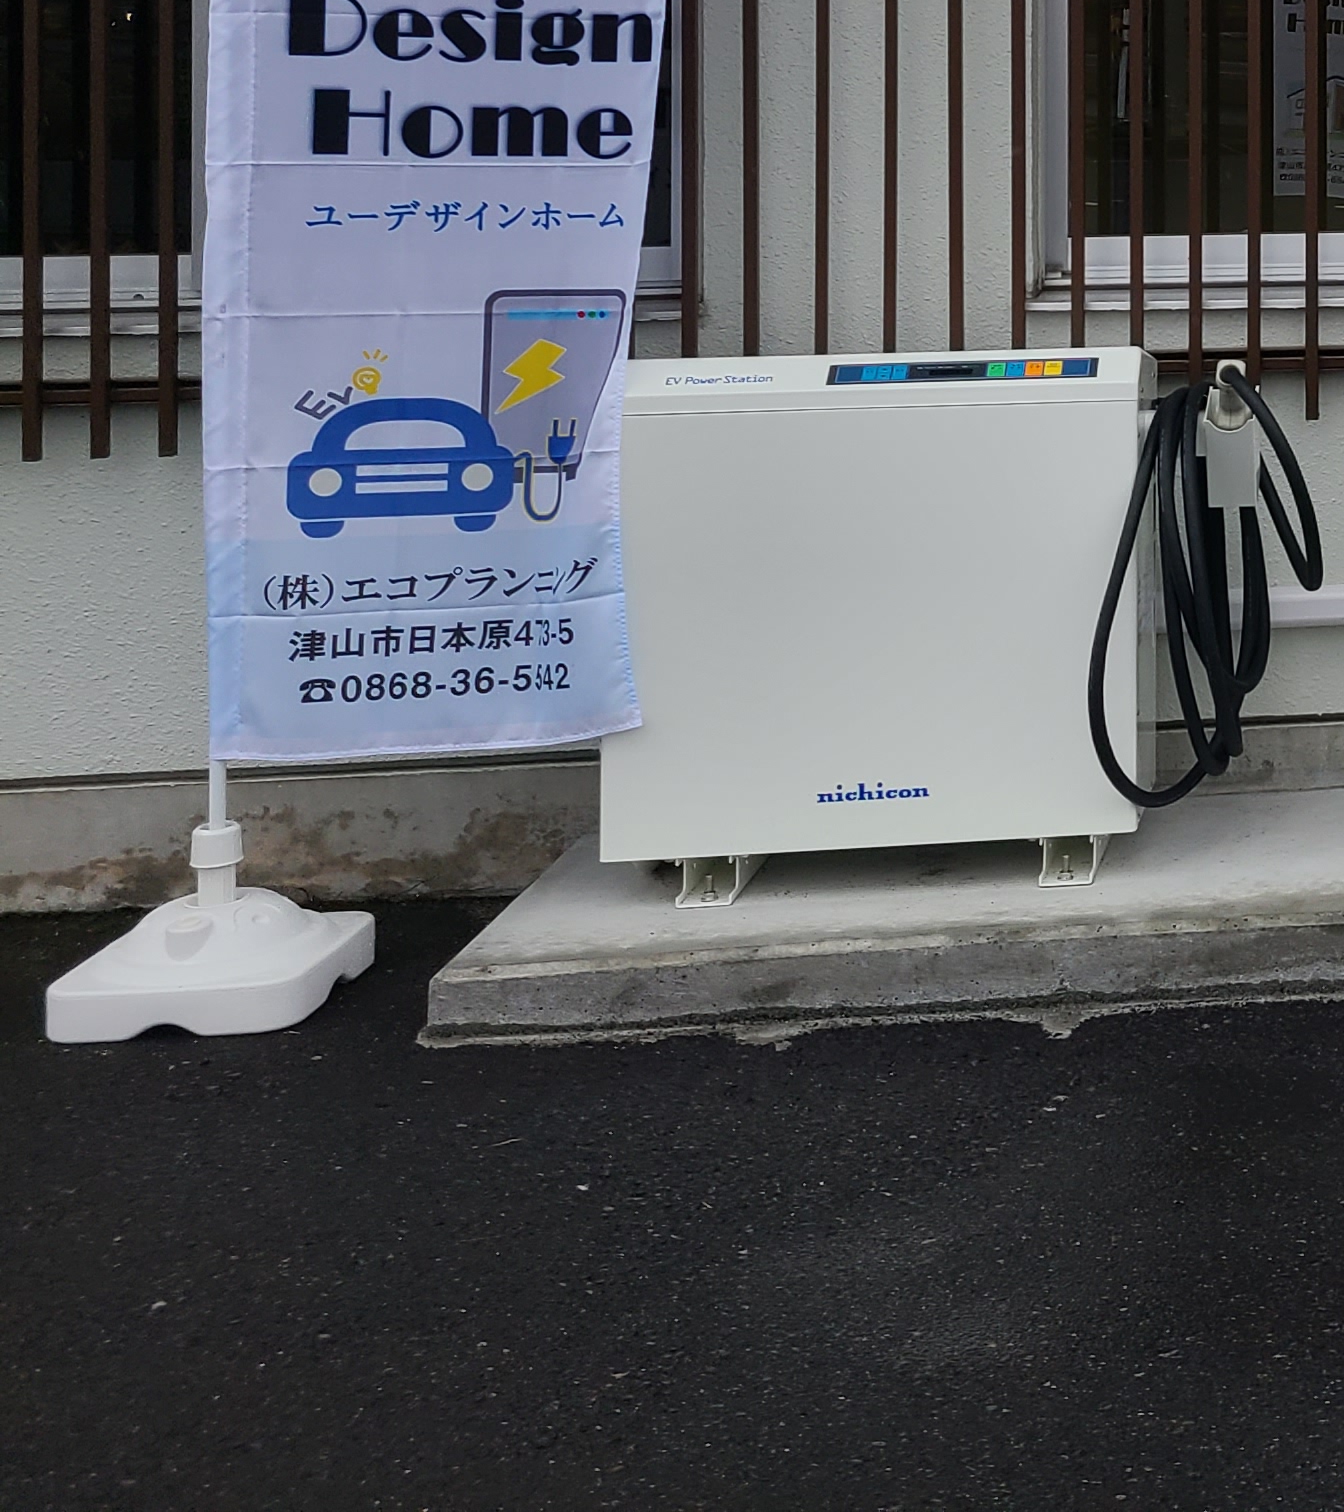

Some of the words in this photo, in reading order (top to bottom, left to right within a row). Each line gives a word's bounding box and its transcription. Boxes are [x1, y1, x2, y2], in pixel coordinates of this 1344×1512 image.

[311, 88, 634, 160] Home
[305, 199, 625, 233] ユーデザインホーム
[665, 376, 682, 386] EV
[684, 375, 722, 385] Power
[723, 374, 774, 384] Station
[294, 386, 353, 420] EV
[288, 618, 575, 663] 津山市日本原473-5
[816, 781, 930, 804] nichicon
